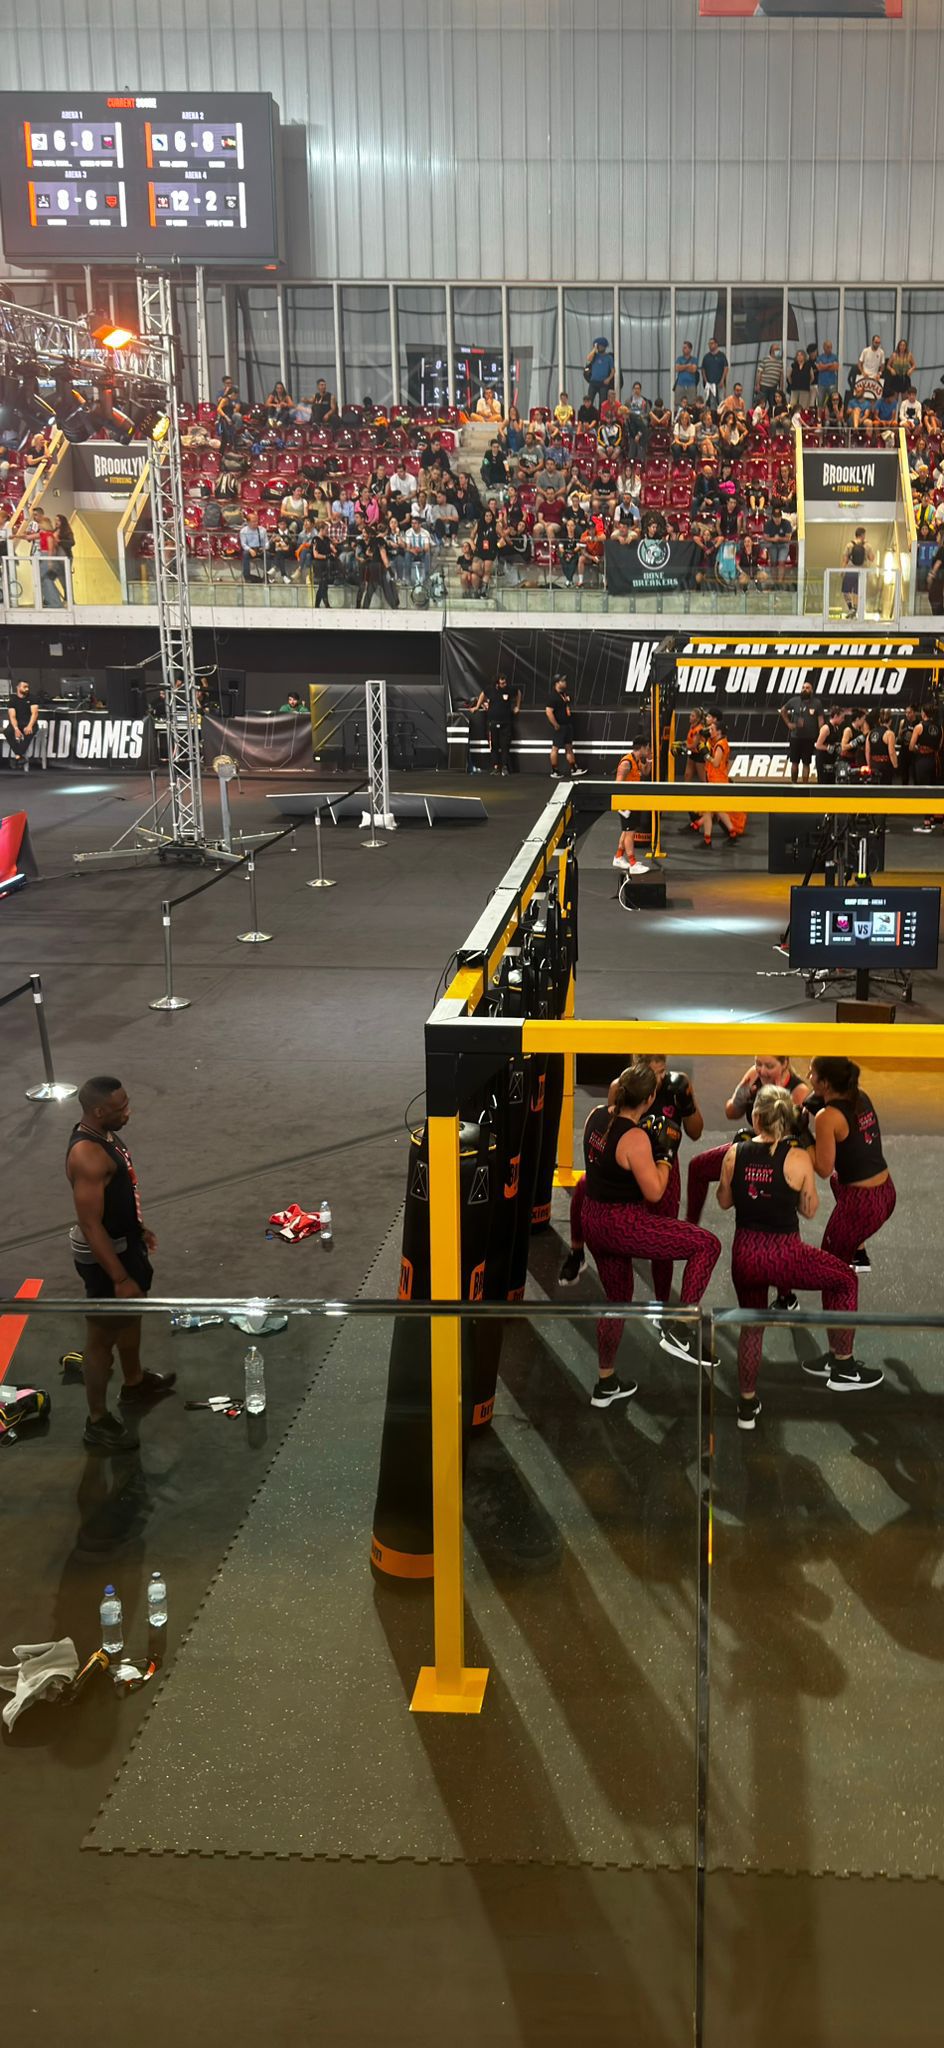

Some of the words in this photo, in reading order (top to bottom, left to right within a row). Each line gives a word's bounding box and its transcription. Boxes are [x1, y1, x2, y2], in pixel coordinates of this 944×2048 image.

[61, 111, 79, 119] ARENA
[182, 111, 199, 120] ARENA
[200, 111, 204, 120] 2
[53, 129, 66, 151] 6
[81, 129, 94, 151] 8
[174, 130, 187, 152] 6
[202, 130, 215, 152] 8
[64, 170, 81, 178] ARENA
[83, 170, 87, 178] 3
[184, 171, 202, 180] ARENA
[202, 171, 207, 179] 4
[57, 189, 70, 210] 8
[85, 189, 97, 210] 6
[170, 190, 189, 211] 12
[205, 190, 217, 211] 2
[93, 454, 146, 478] BROOKLYN
[822, 462, 875, 487] BROOKLYN
[632, 578, 679, 588] BREAKERS
[643, 571, 665, 580] BONE
[76, 719, 144, 759] GAMES
[857, 923, 869, 936] VS
